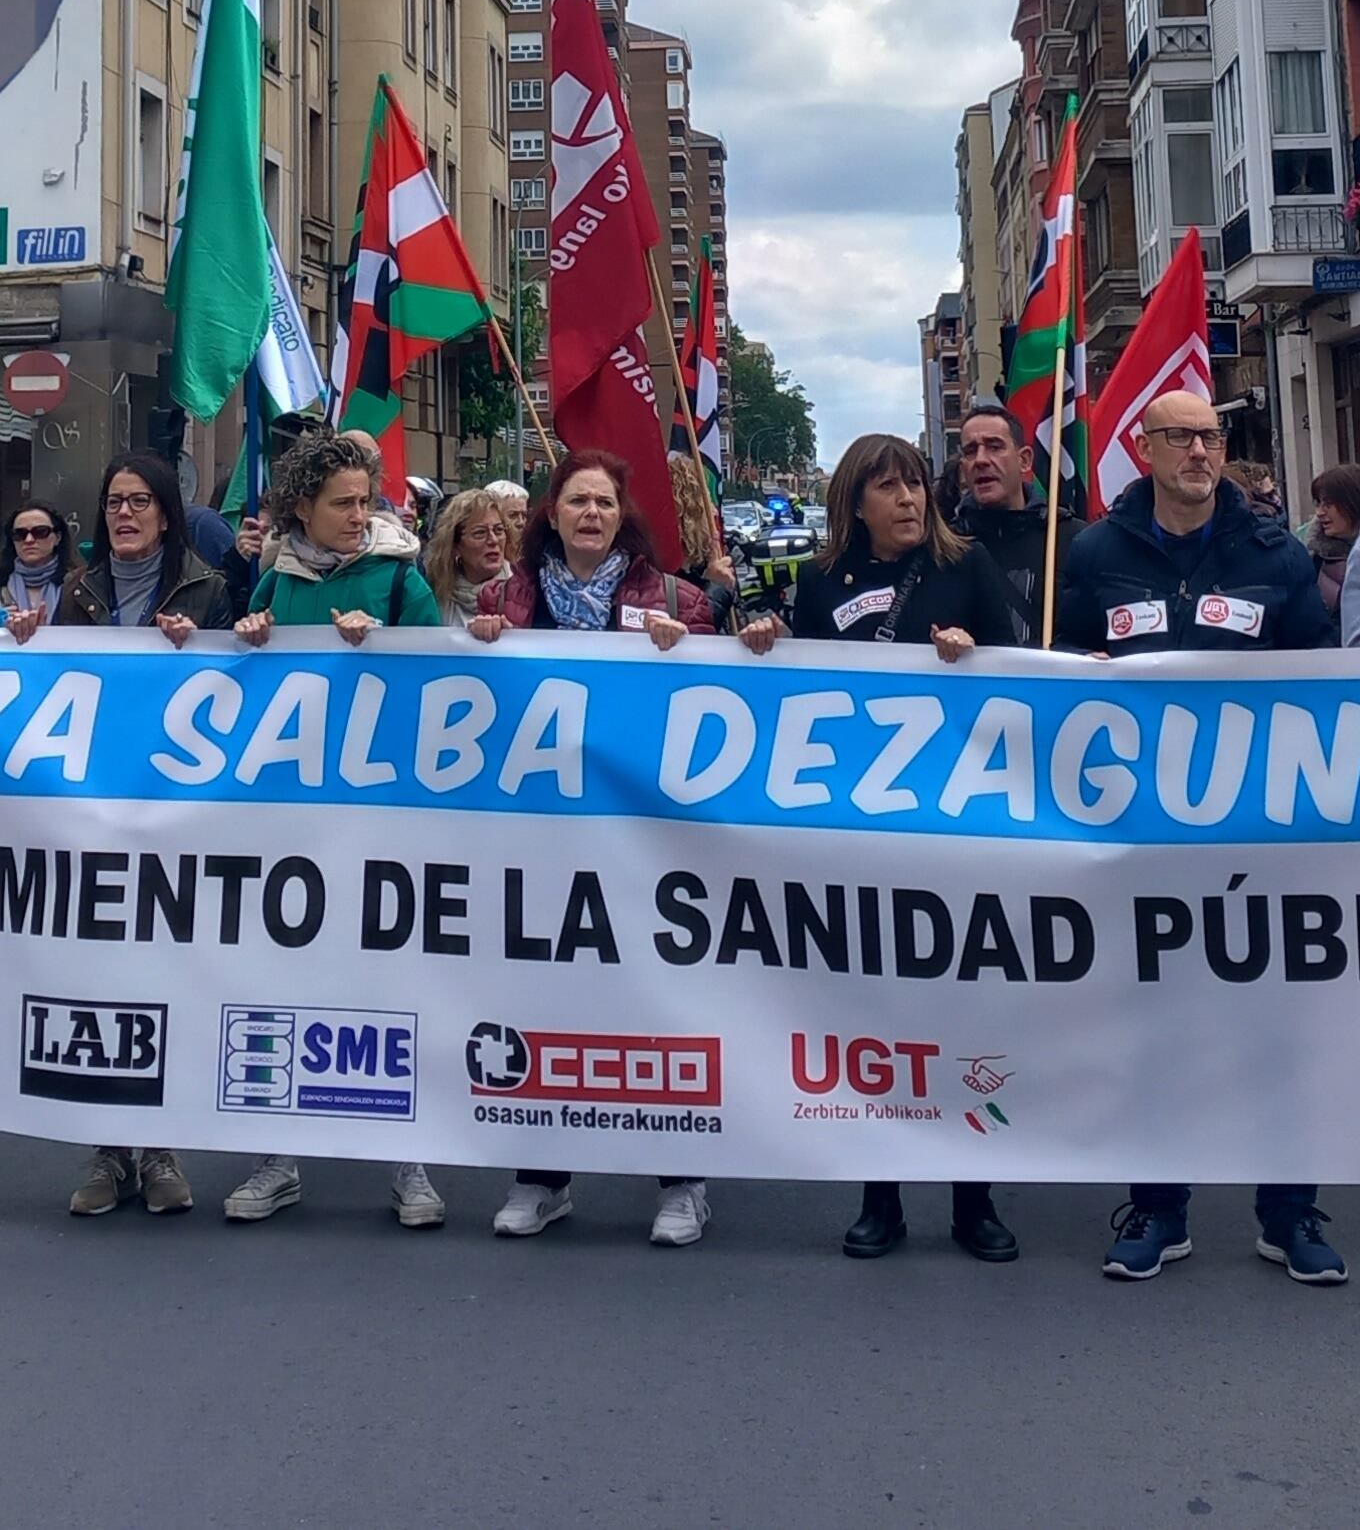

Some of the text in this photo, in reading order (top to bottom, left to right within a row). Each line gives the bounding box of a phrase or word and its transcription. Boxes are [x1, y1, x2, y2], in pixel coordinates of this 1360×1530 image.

[1213, 303, 1237, 316] Bar
[149, 667, 589, 800] SALBA
[361, 859, 471, 957] DE
[504, 867, 622, 965] LA
[653, 870, 1095, 983] SANIDAD
[26, 1004, 157, 1072] LAB
[300, 1021, 412, 1078] SME
[791, 1032, 940, 1098] UGT
[540, 1046, 708, 1093] CCOO
[474, 1104, 722, 1134] osasun federakundea
[793, 1102, 943, 1122] Zerbitzu Publikoak
